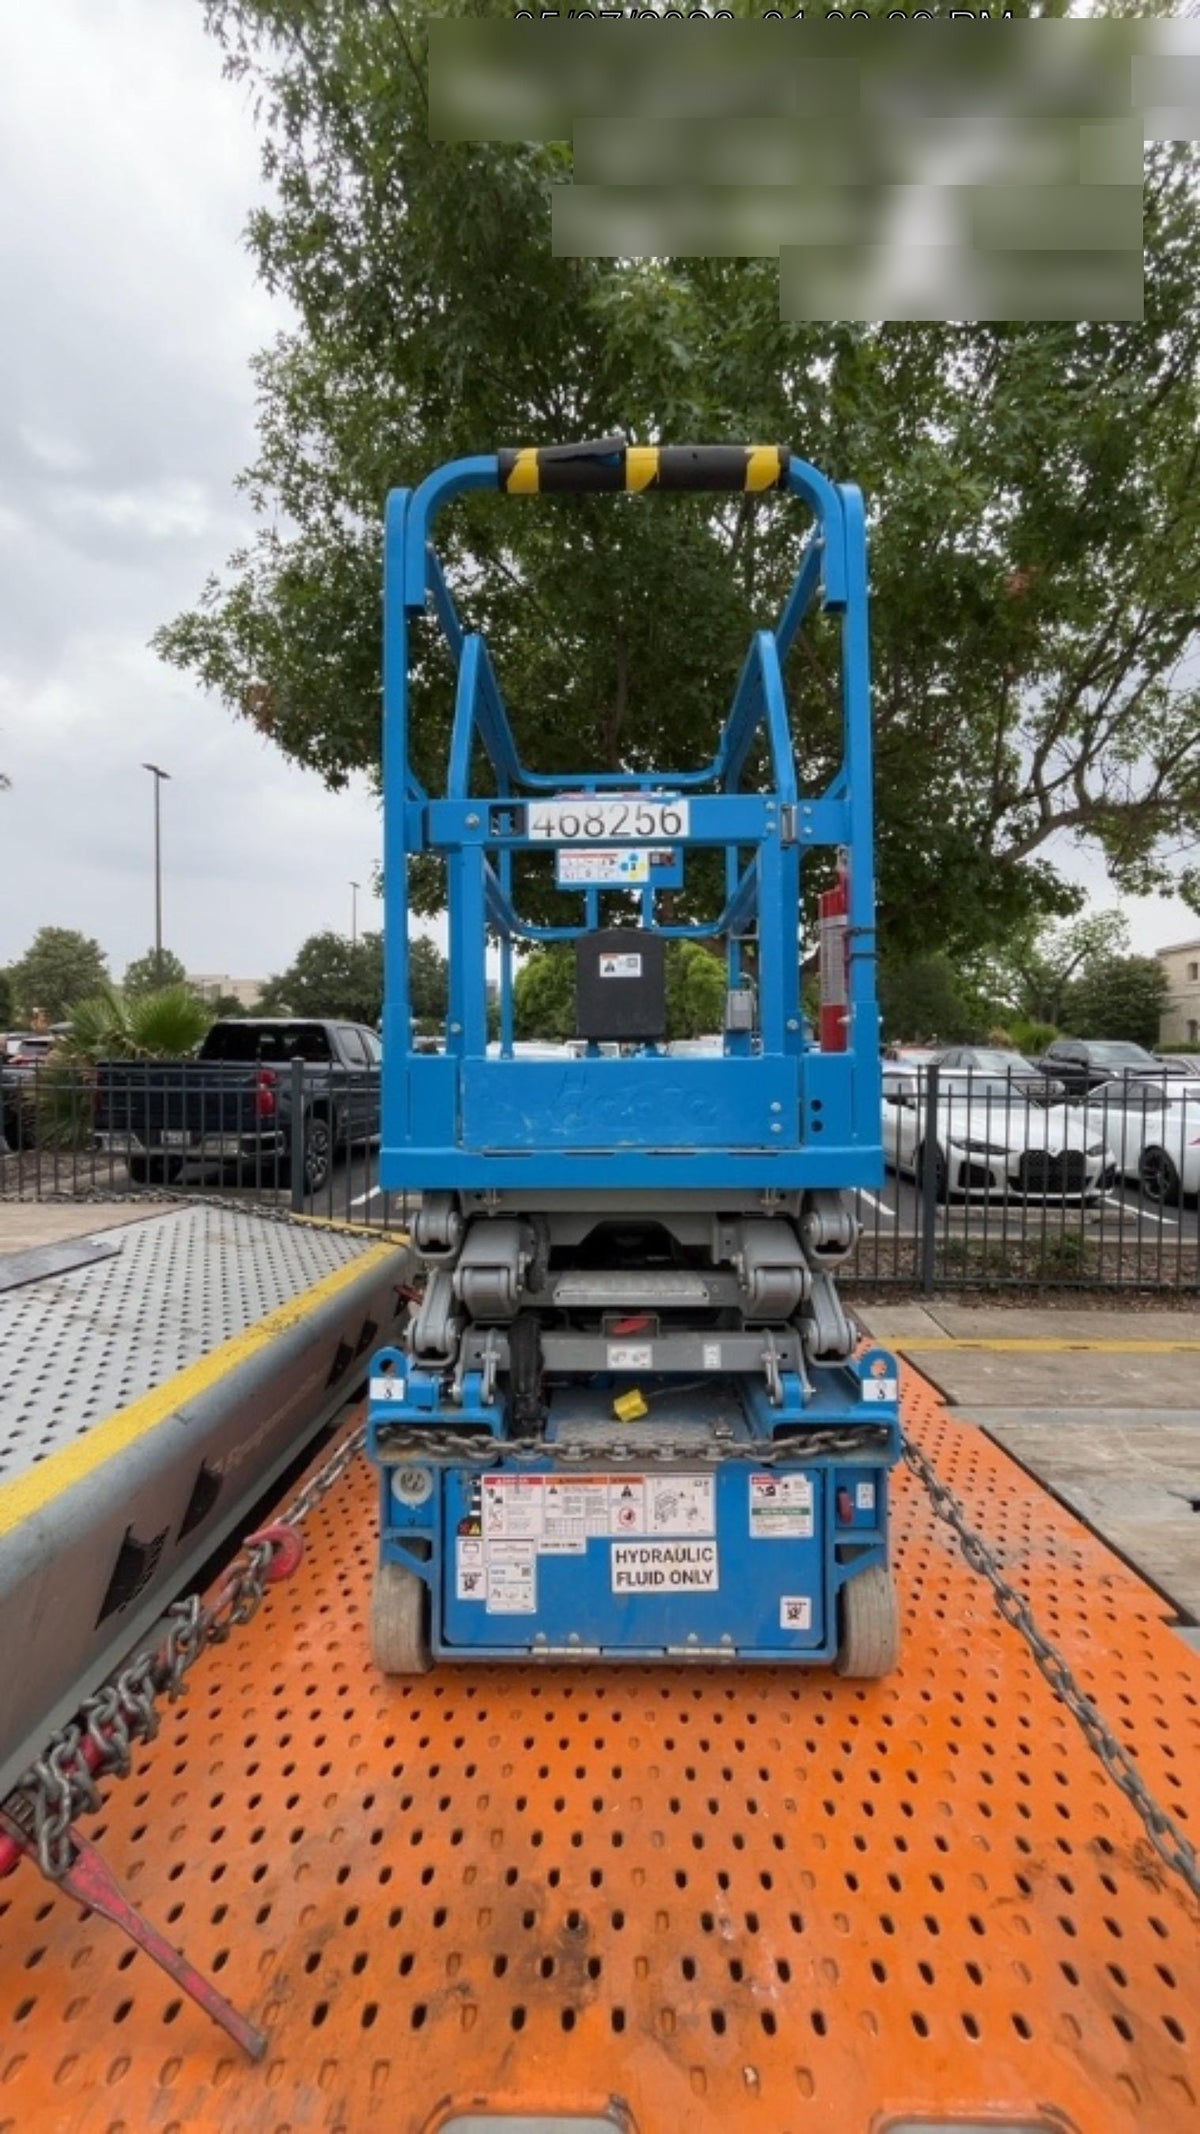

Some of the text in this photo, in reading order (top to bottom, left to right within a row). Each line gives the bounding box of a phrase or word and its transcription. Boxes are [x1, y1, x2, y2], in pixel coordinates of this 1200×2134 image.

[532, 803, 682, 838] 468256
[615, 1547, 713, 1564] HYDRAULIC
[616, 1569, 714, 1587] FLUID ONLY
